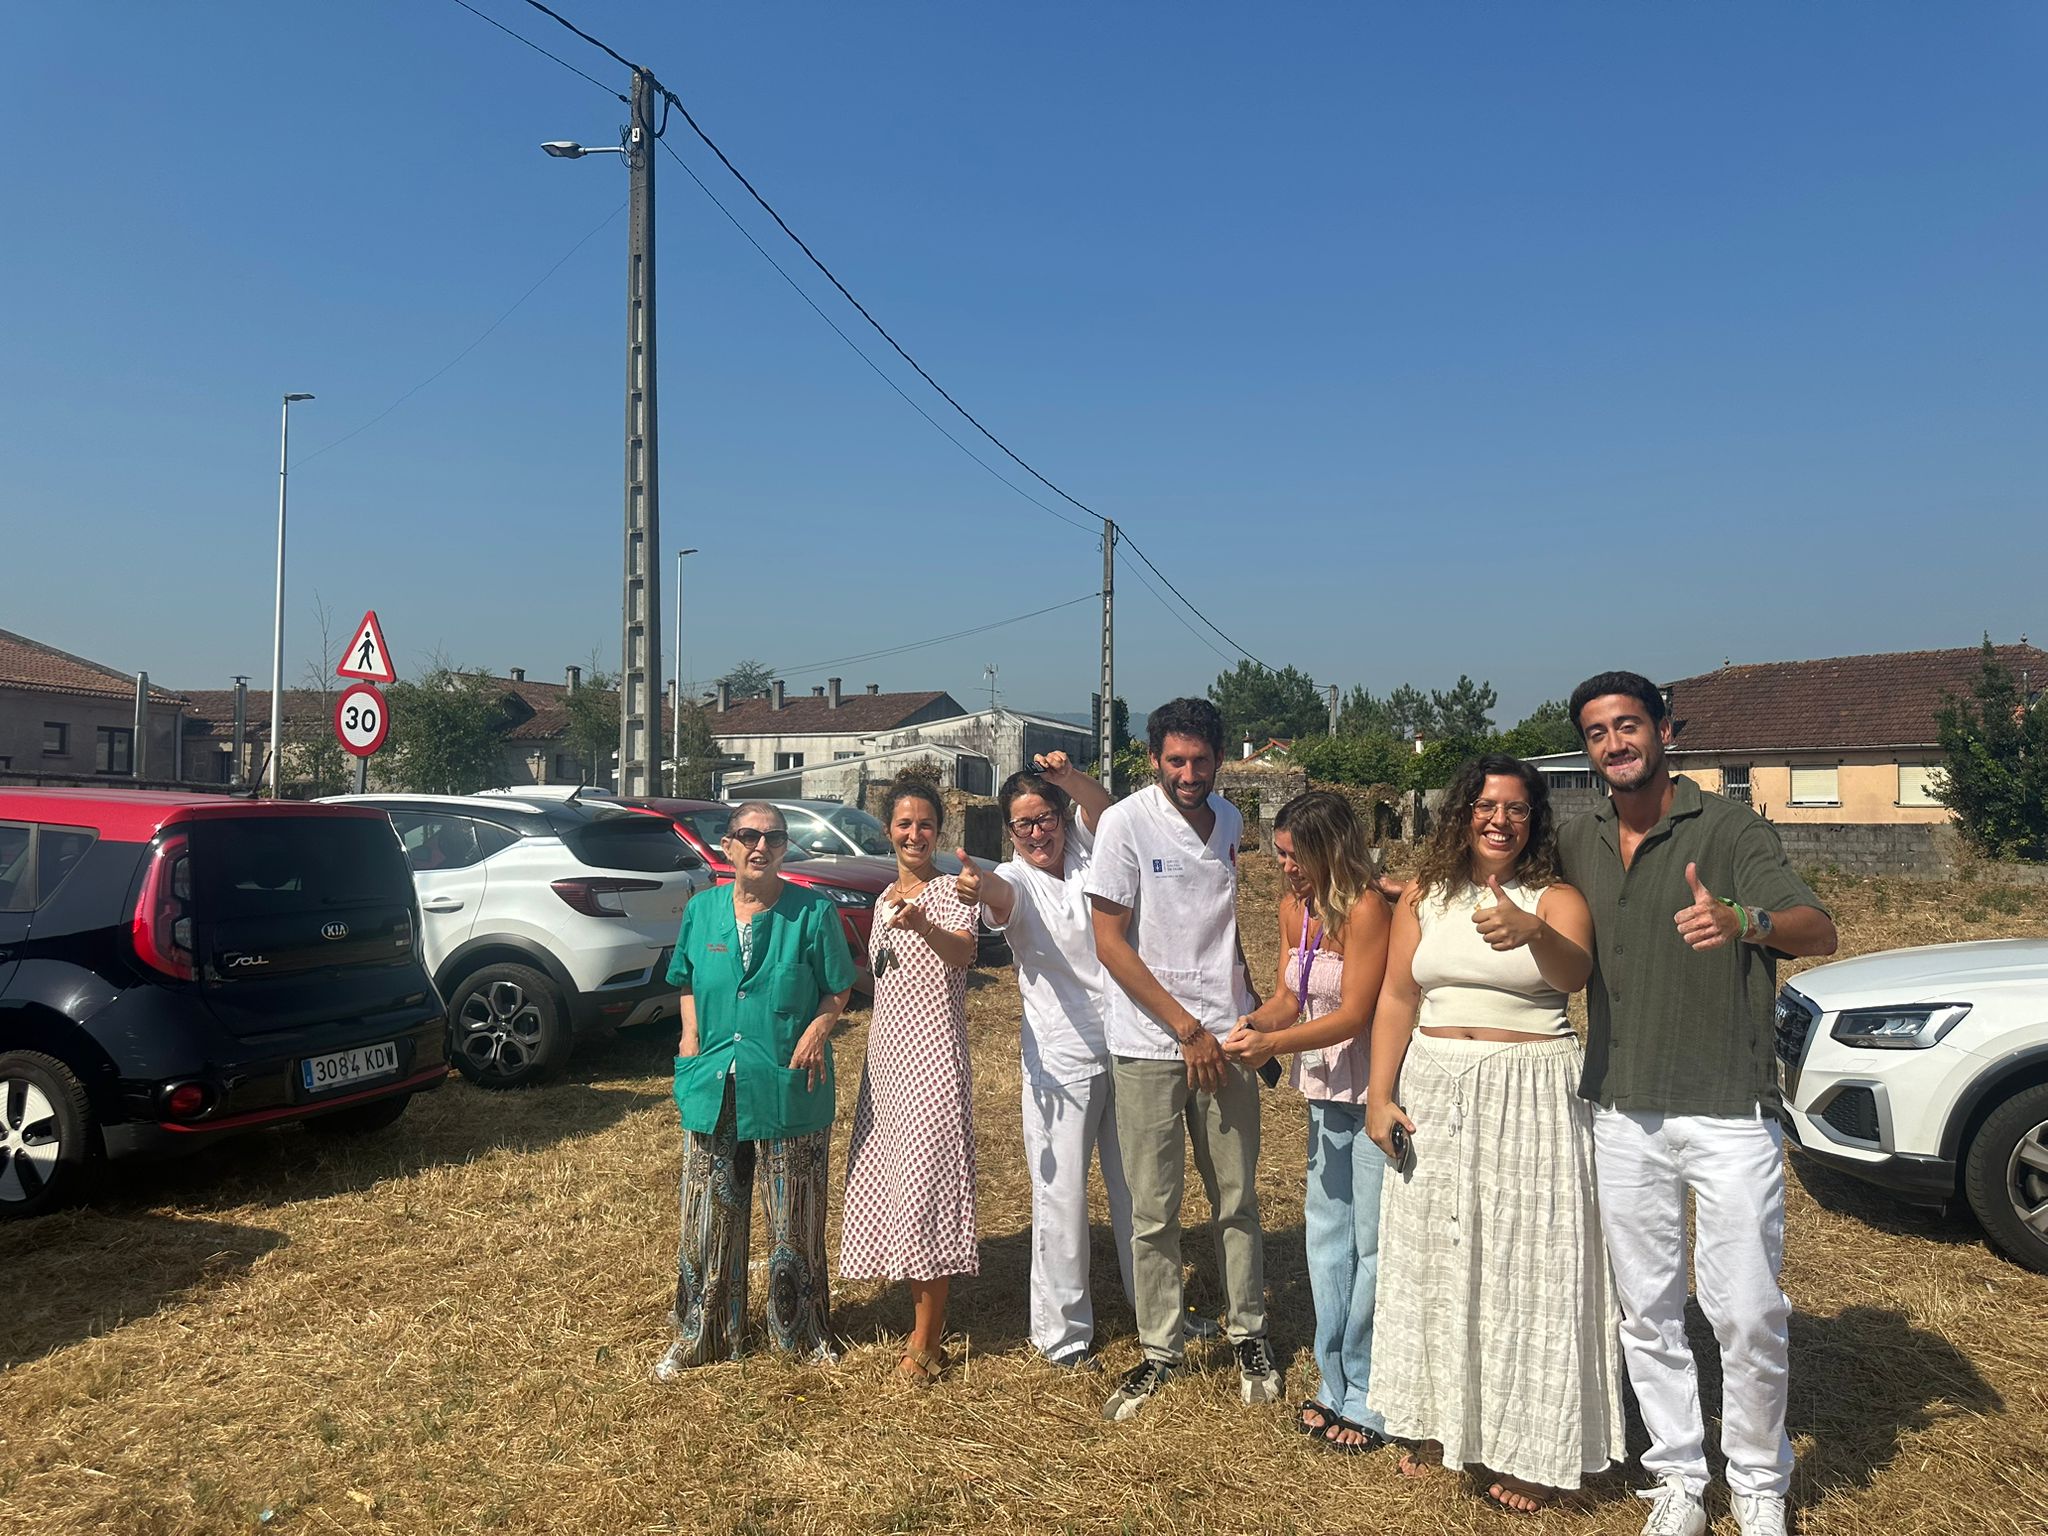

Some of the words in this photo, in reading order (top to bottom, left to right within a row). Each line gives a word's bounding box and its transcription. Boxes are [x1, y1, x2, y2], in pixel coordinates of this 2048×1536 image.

[345, 706, 376, 733] 30
[327, 924, 346, 936] KIA
[316, 1053, 360, 1081] 3084
[364, 1046, 395, 1071] KDW
